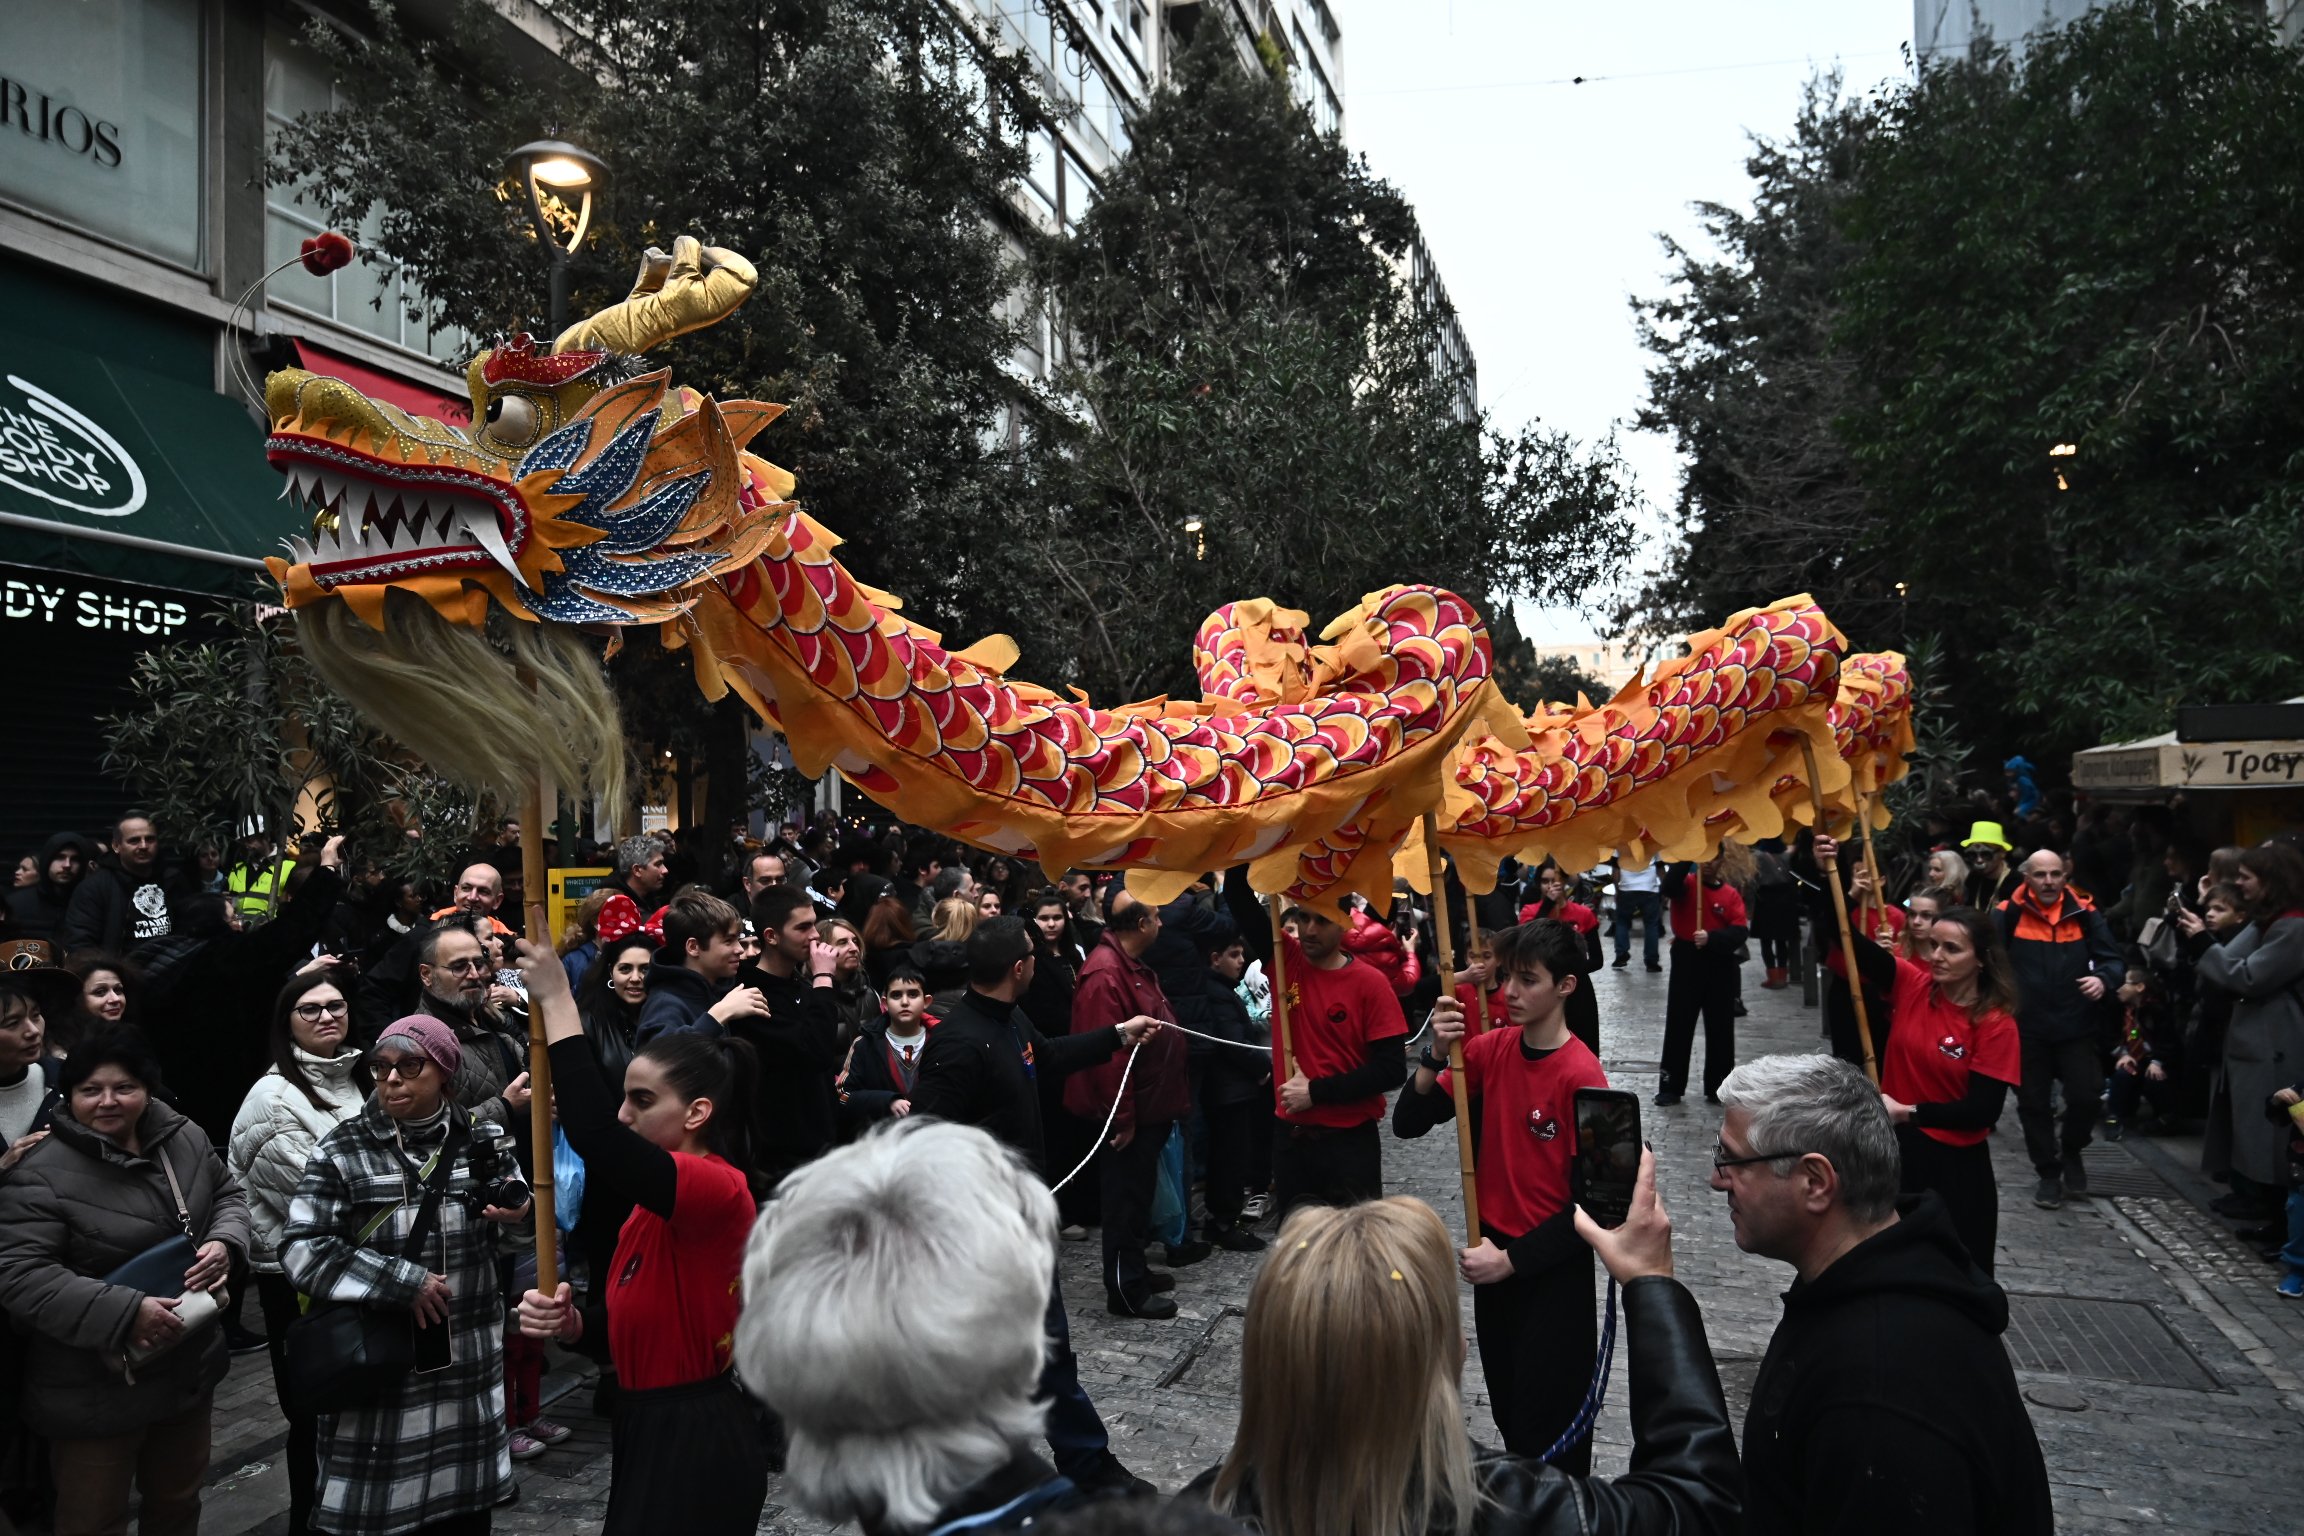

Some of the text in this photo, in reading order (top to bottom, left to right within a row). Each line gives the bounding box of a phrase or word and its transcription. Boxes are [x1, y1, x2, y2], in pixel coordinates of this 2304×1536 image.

[0, 405, 60, 443] HE
[0, 426, 98, 474] ODY
[0, 448, 111, 496] SHOP
[0, 580, 187, 636] DY SHOP
